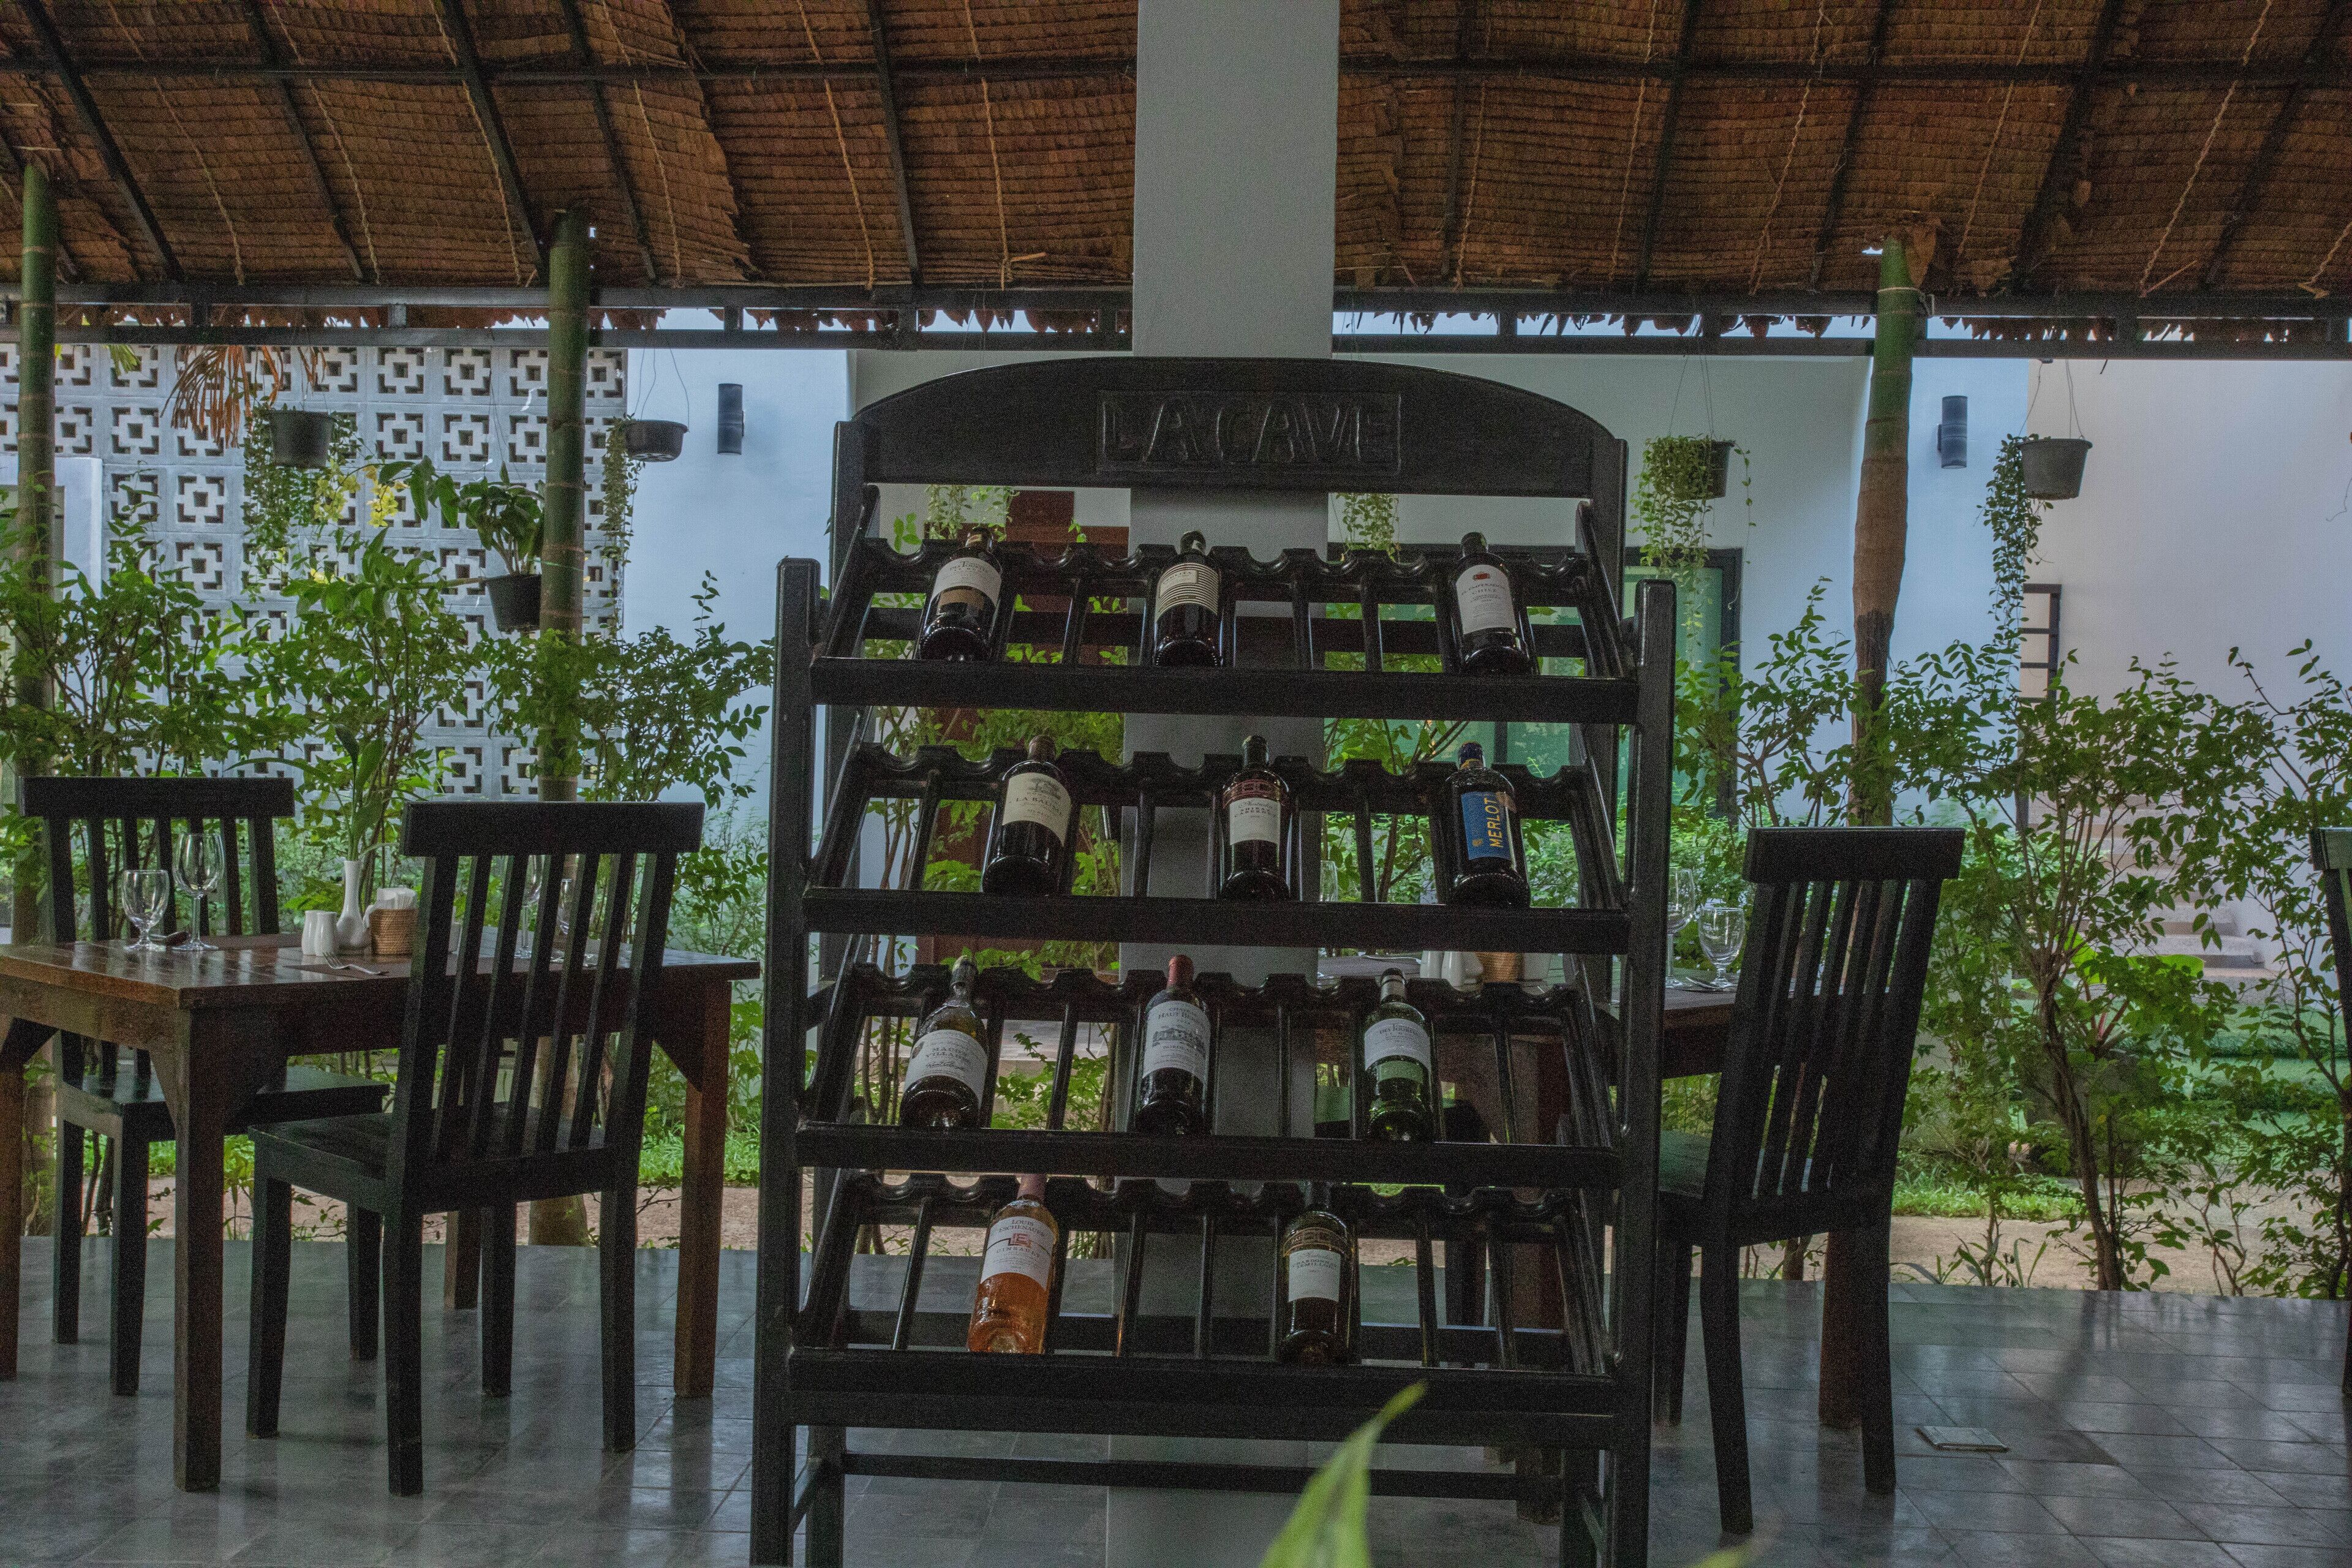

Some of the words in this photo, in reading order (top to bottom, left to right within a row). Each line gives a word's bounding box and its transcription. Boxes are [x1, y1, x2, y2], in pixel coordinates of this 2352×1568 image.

[1101, 401, 1202, 466] LA
[1213, 399, 1393, 466] CAVE
[1484, 797, 1503, 848] MERLOT
